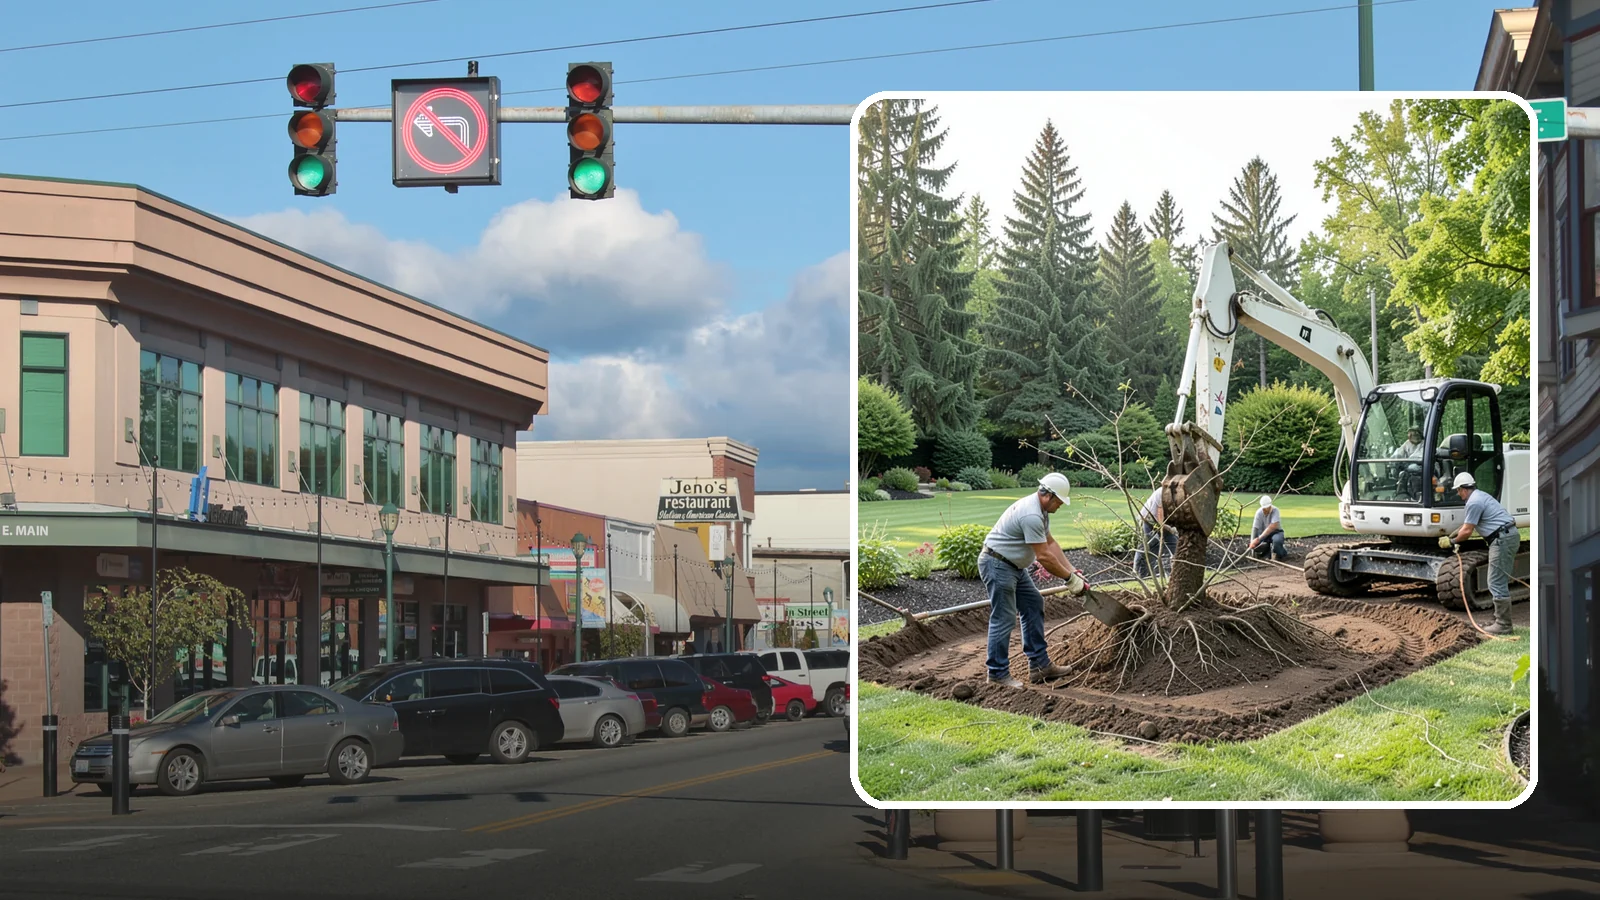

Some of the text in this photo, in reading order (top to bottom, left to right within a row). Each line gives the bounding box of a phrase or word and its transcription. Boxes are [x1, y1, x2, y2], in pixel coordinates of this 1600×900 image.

[670, 480, 727, 494] Jeno's
[665, 496, 731, 509] restaurant
[658, 509, 682, 519] Italian
[686, 509, 715, 519] American
[715, 509, 737, 519] Cuisine
[2, 525, 49, 536] E. MAIN
[797, 607, 828, 616] Street
[790, 619, 824, 627] lass
